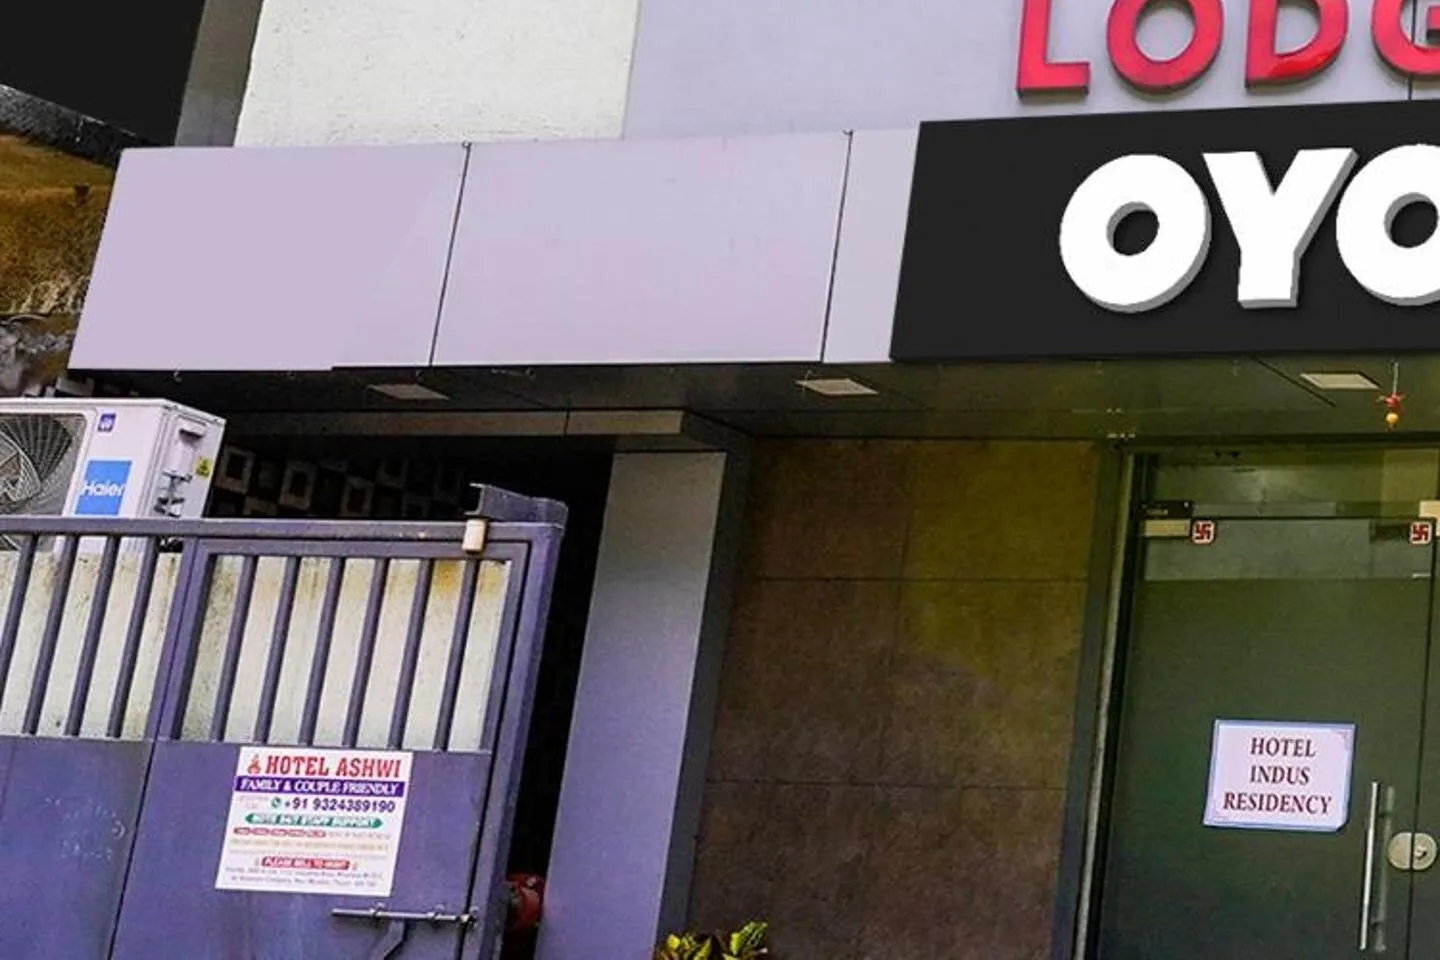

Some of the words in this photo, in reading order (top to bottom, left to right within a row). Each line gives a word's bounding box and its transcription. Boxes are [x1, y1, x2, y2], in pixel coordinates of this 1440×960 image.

[78, 478, 124, 496] Haier
[1250, 737, 1316, 758] HOTEL
[265, 755, 329, 776] HOTEL
[336, 758, 400, 778] ASHWI
[1251, 765, 1310, 785] INDUS
[240, 778, 280, 791] FAMILY
[282, 780, 291, 791] &
[294, 780, 341, 793] COUPLE
[343, 783, 399, 795] FRIENDLY
[285, 797, 308, 809] +91
[313, 798, 396, 813] 9324389190
[1223, 792, 1332, 814] RESIDENCY
